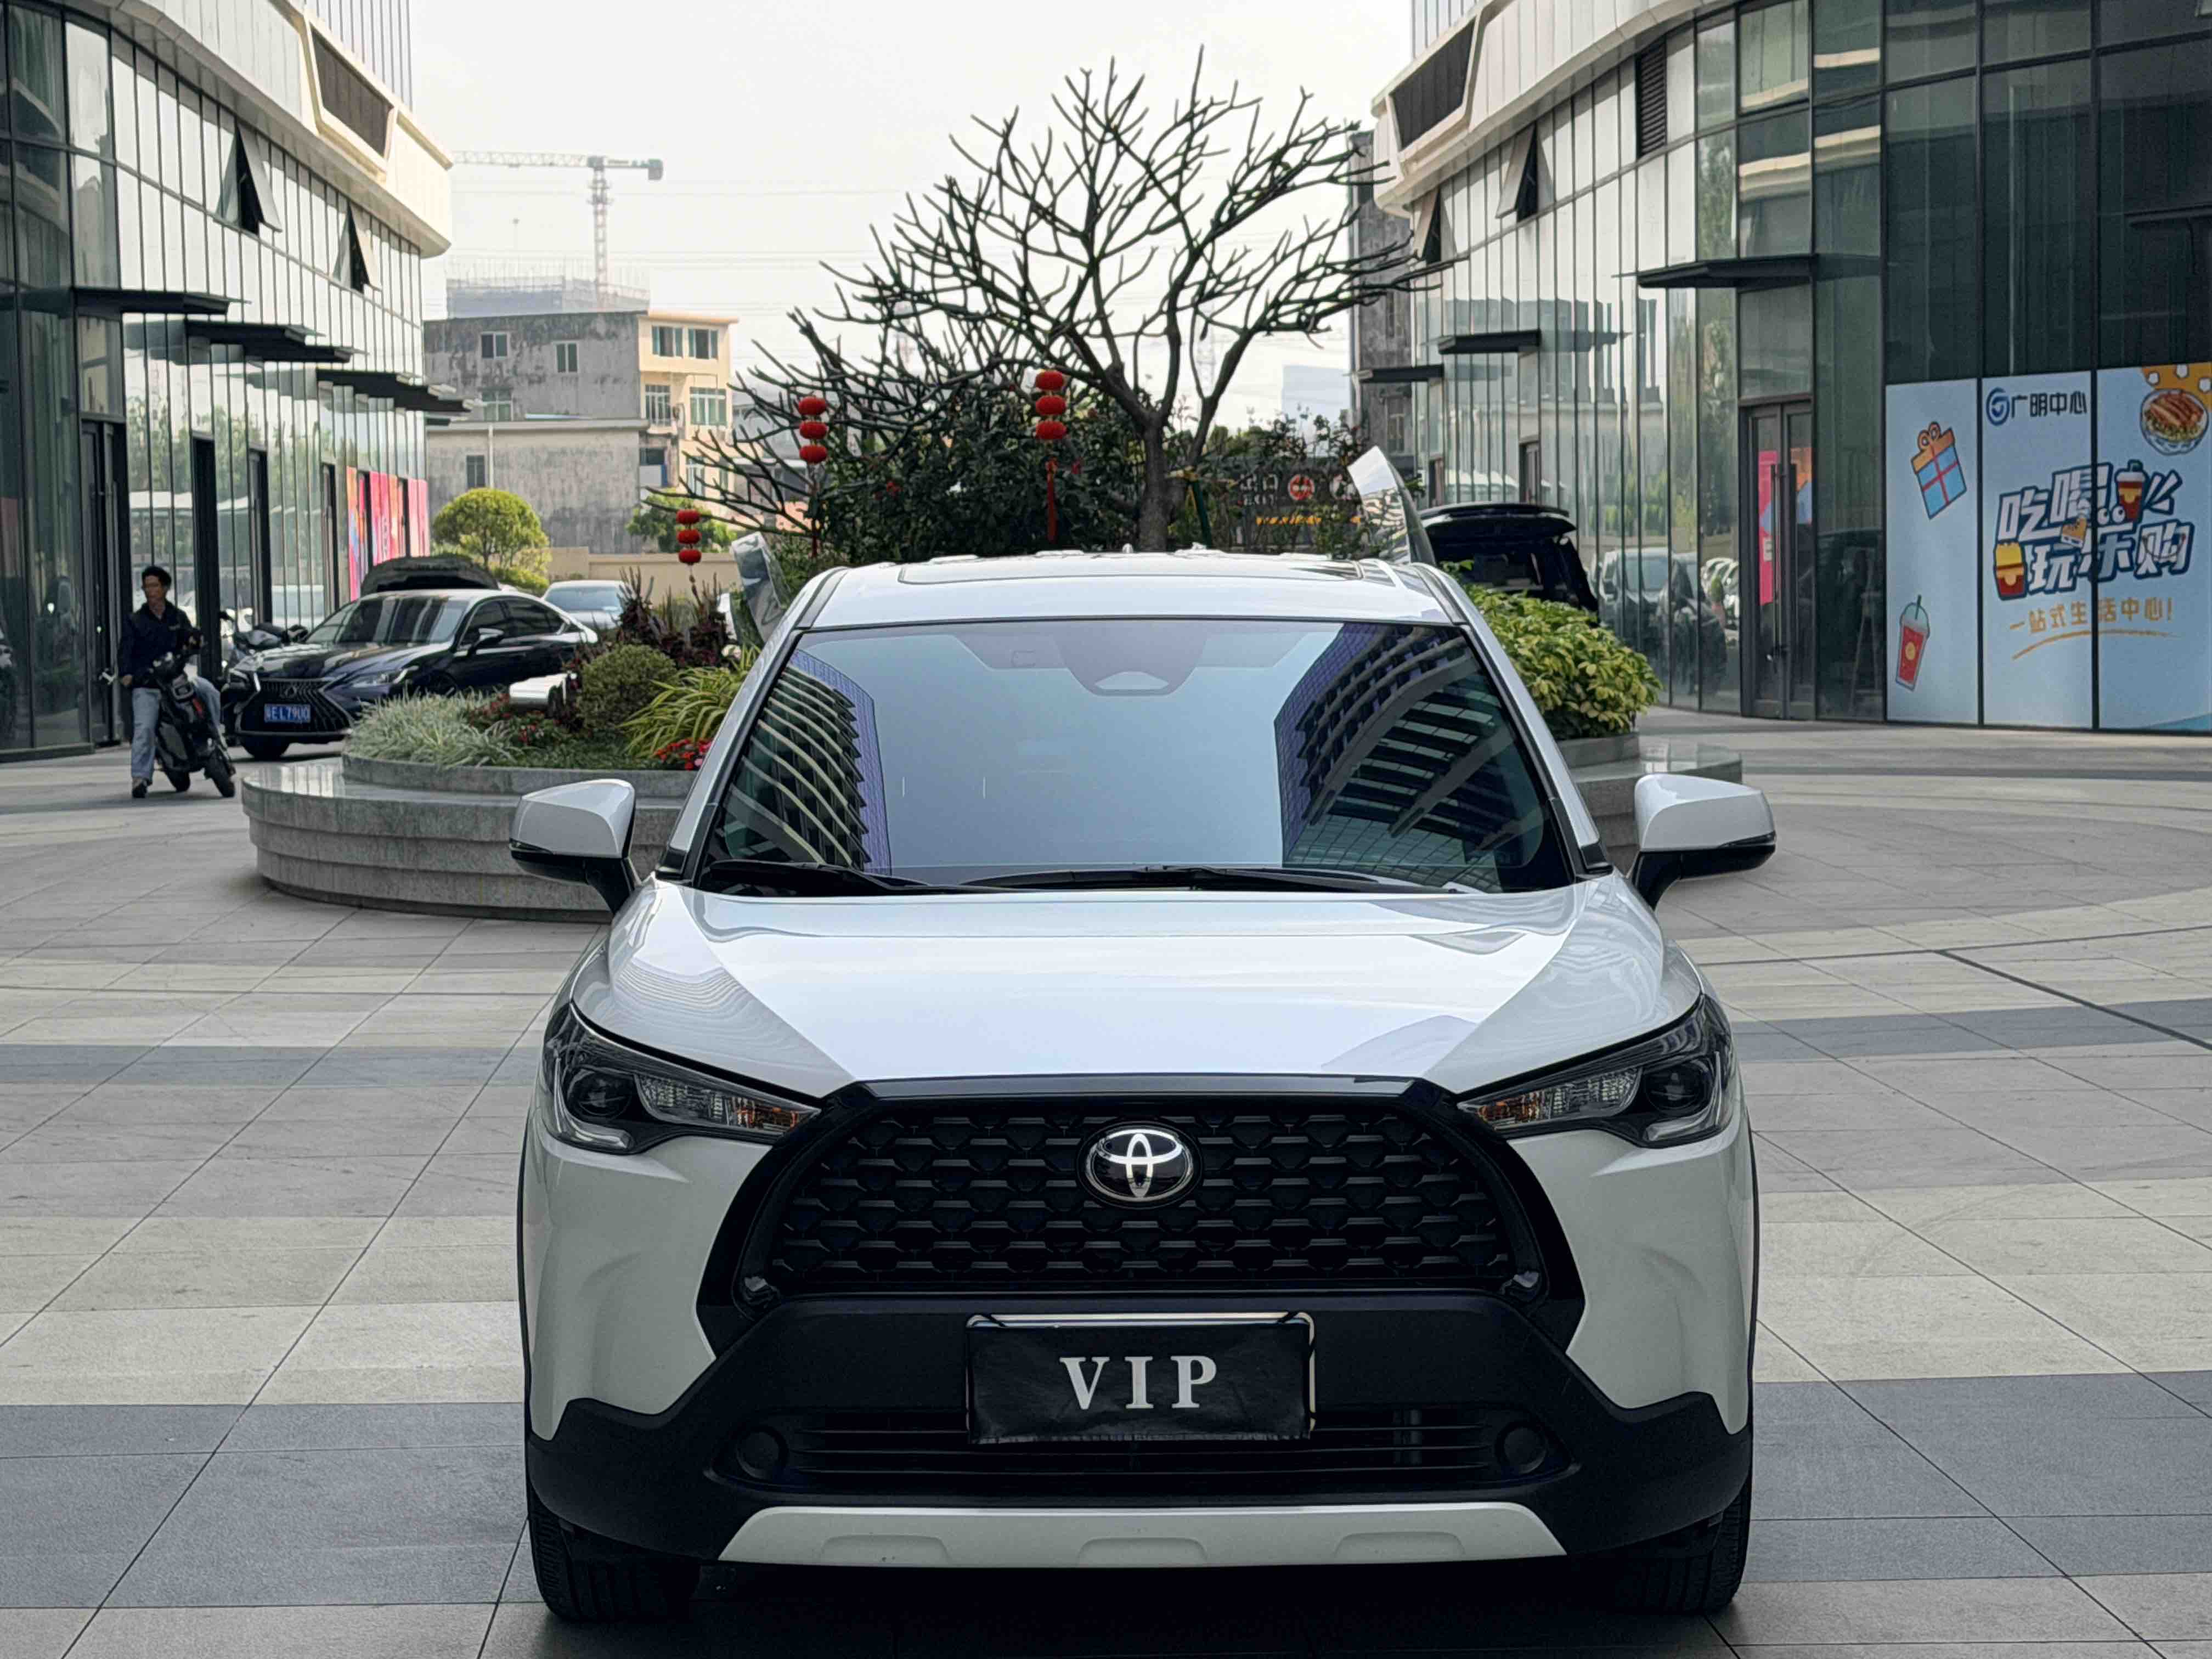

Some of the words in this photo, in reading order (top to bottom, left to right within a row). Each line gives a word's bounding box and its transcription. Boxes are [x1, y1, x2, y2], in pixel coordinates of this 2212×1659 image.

[2011, 391, 2087, 419] 广明中心
[1059, 1355, 1217, 1410] VIP
